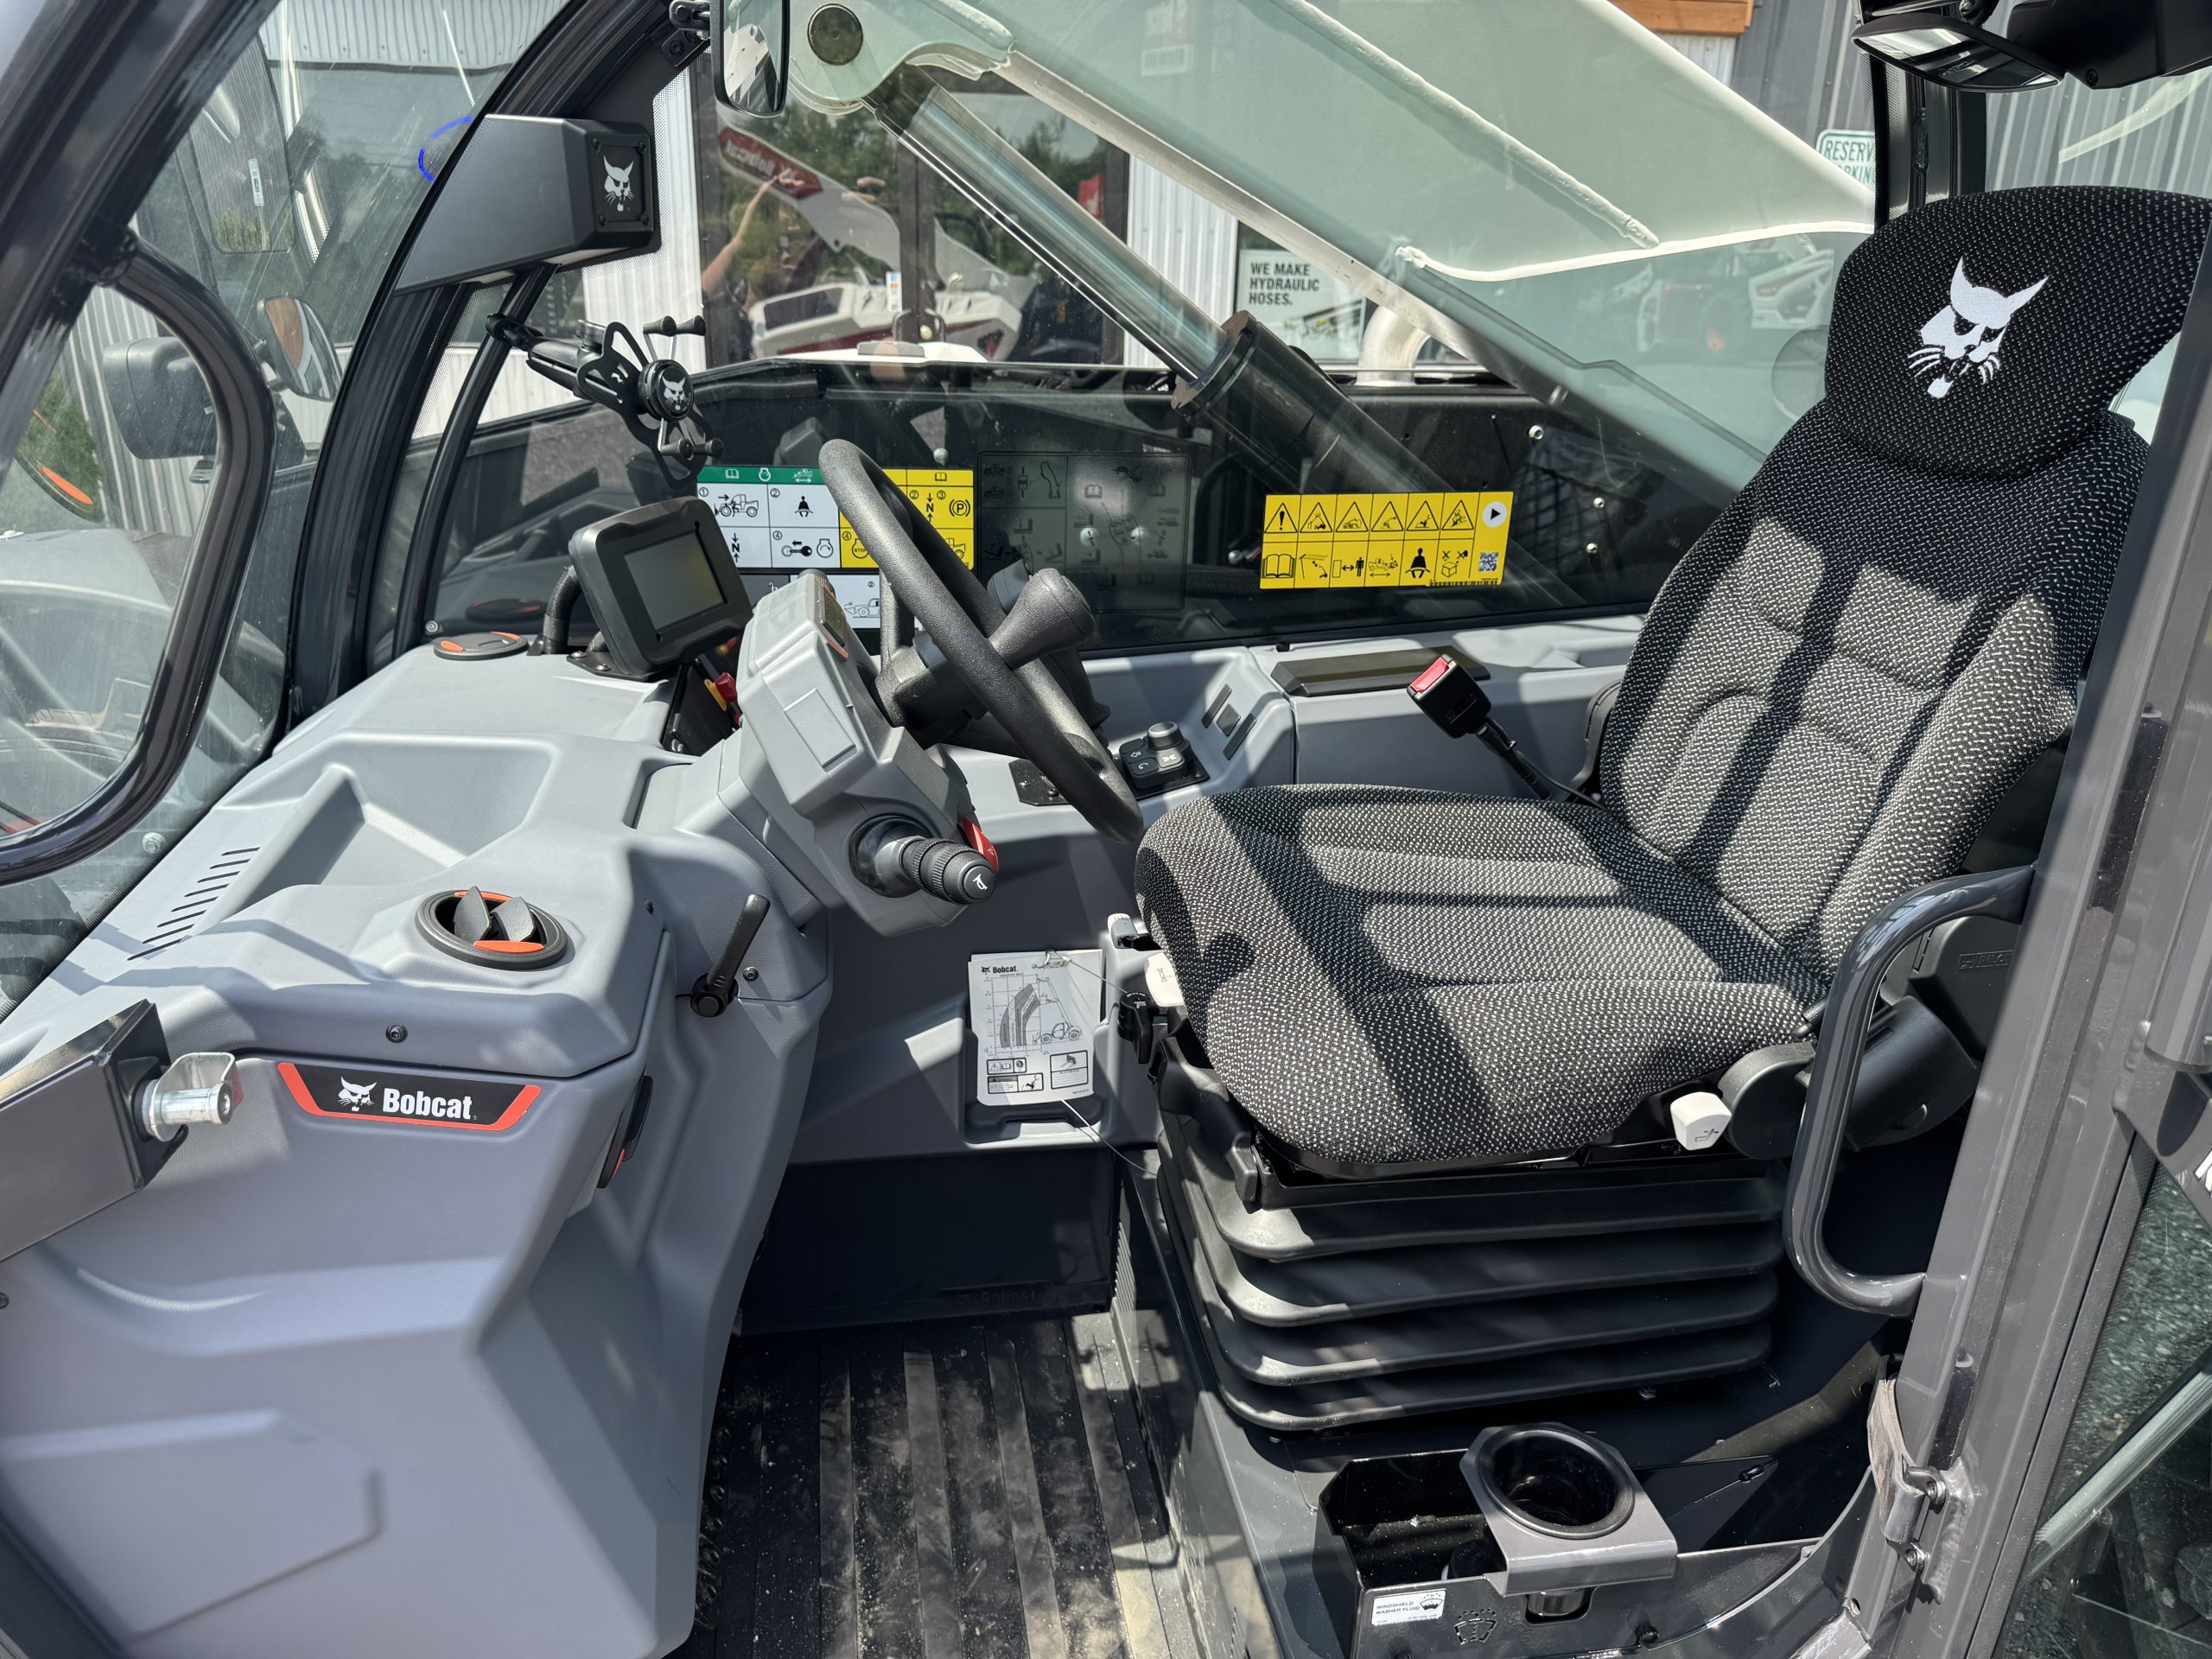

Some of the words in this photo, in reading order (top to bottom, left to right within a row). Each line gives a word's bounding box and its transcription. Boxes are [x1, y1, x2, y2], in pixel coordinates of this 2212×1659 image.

[1251, 263, 1270, 276] WE
[1274, 263, 1310, 276] MAKE
[1249, 277, 1320, 291] HYDRAULIC
[1249, 293, 1293, 306] HOSES.
[993, 965, 1017, 974] Bobcat
[383, 1088, 473, 1120] Bobcat
